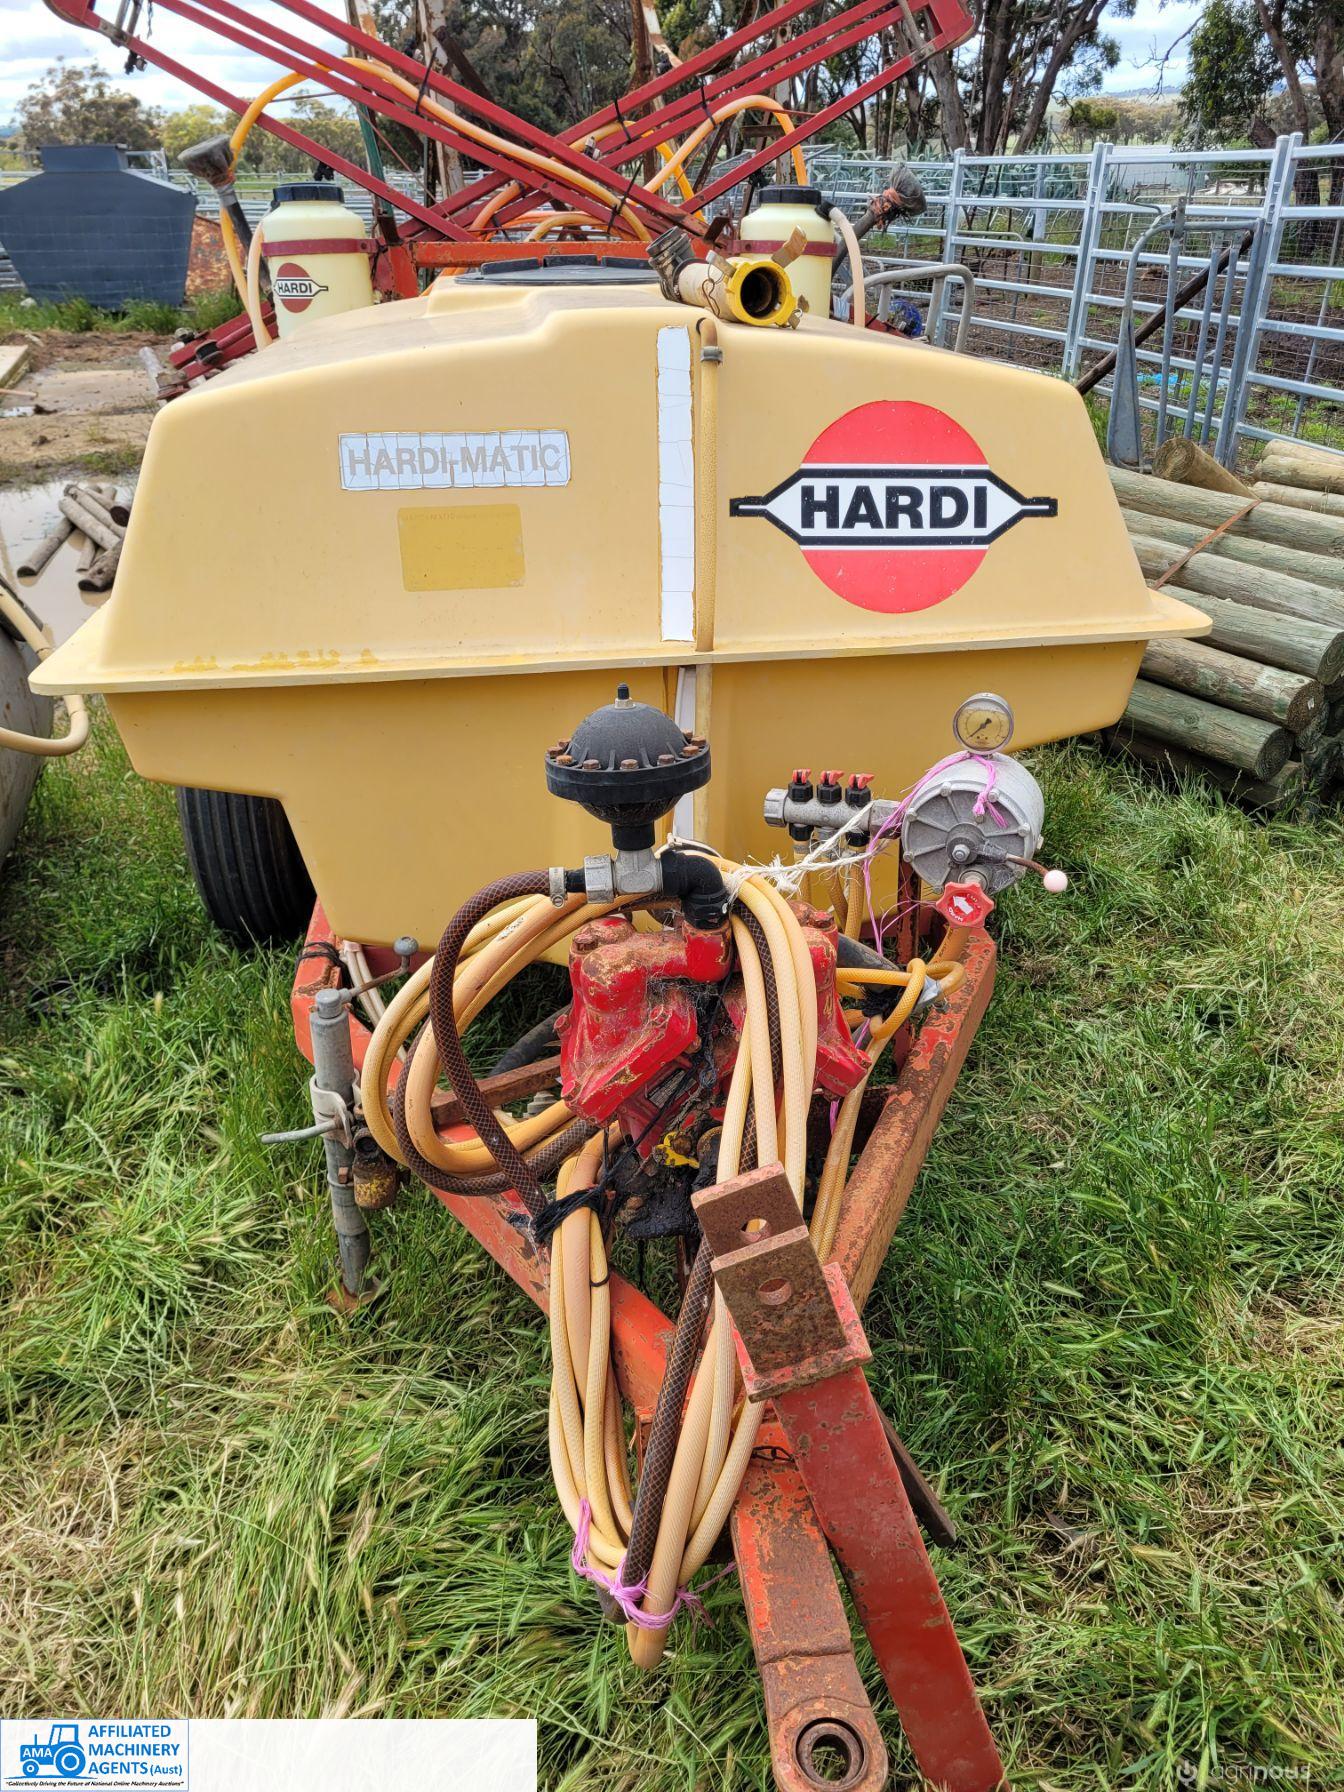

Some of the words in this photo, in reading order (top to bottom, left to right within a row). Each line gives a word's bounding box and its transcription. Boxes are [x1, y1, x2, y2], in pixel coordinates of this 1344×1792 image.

[278, 282, 312, 294] HARDI
[348, 443, 562, 476] HARDI-MATIC
[800, 485, 988, 530] HARDI
